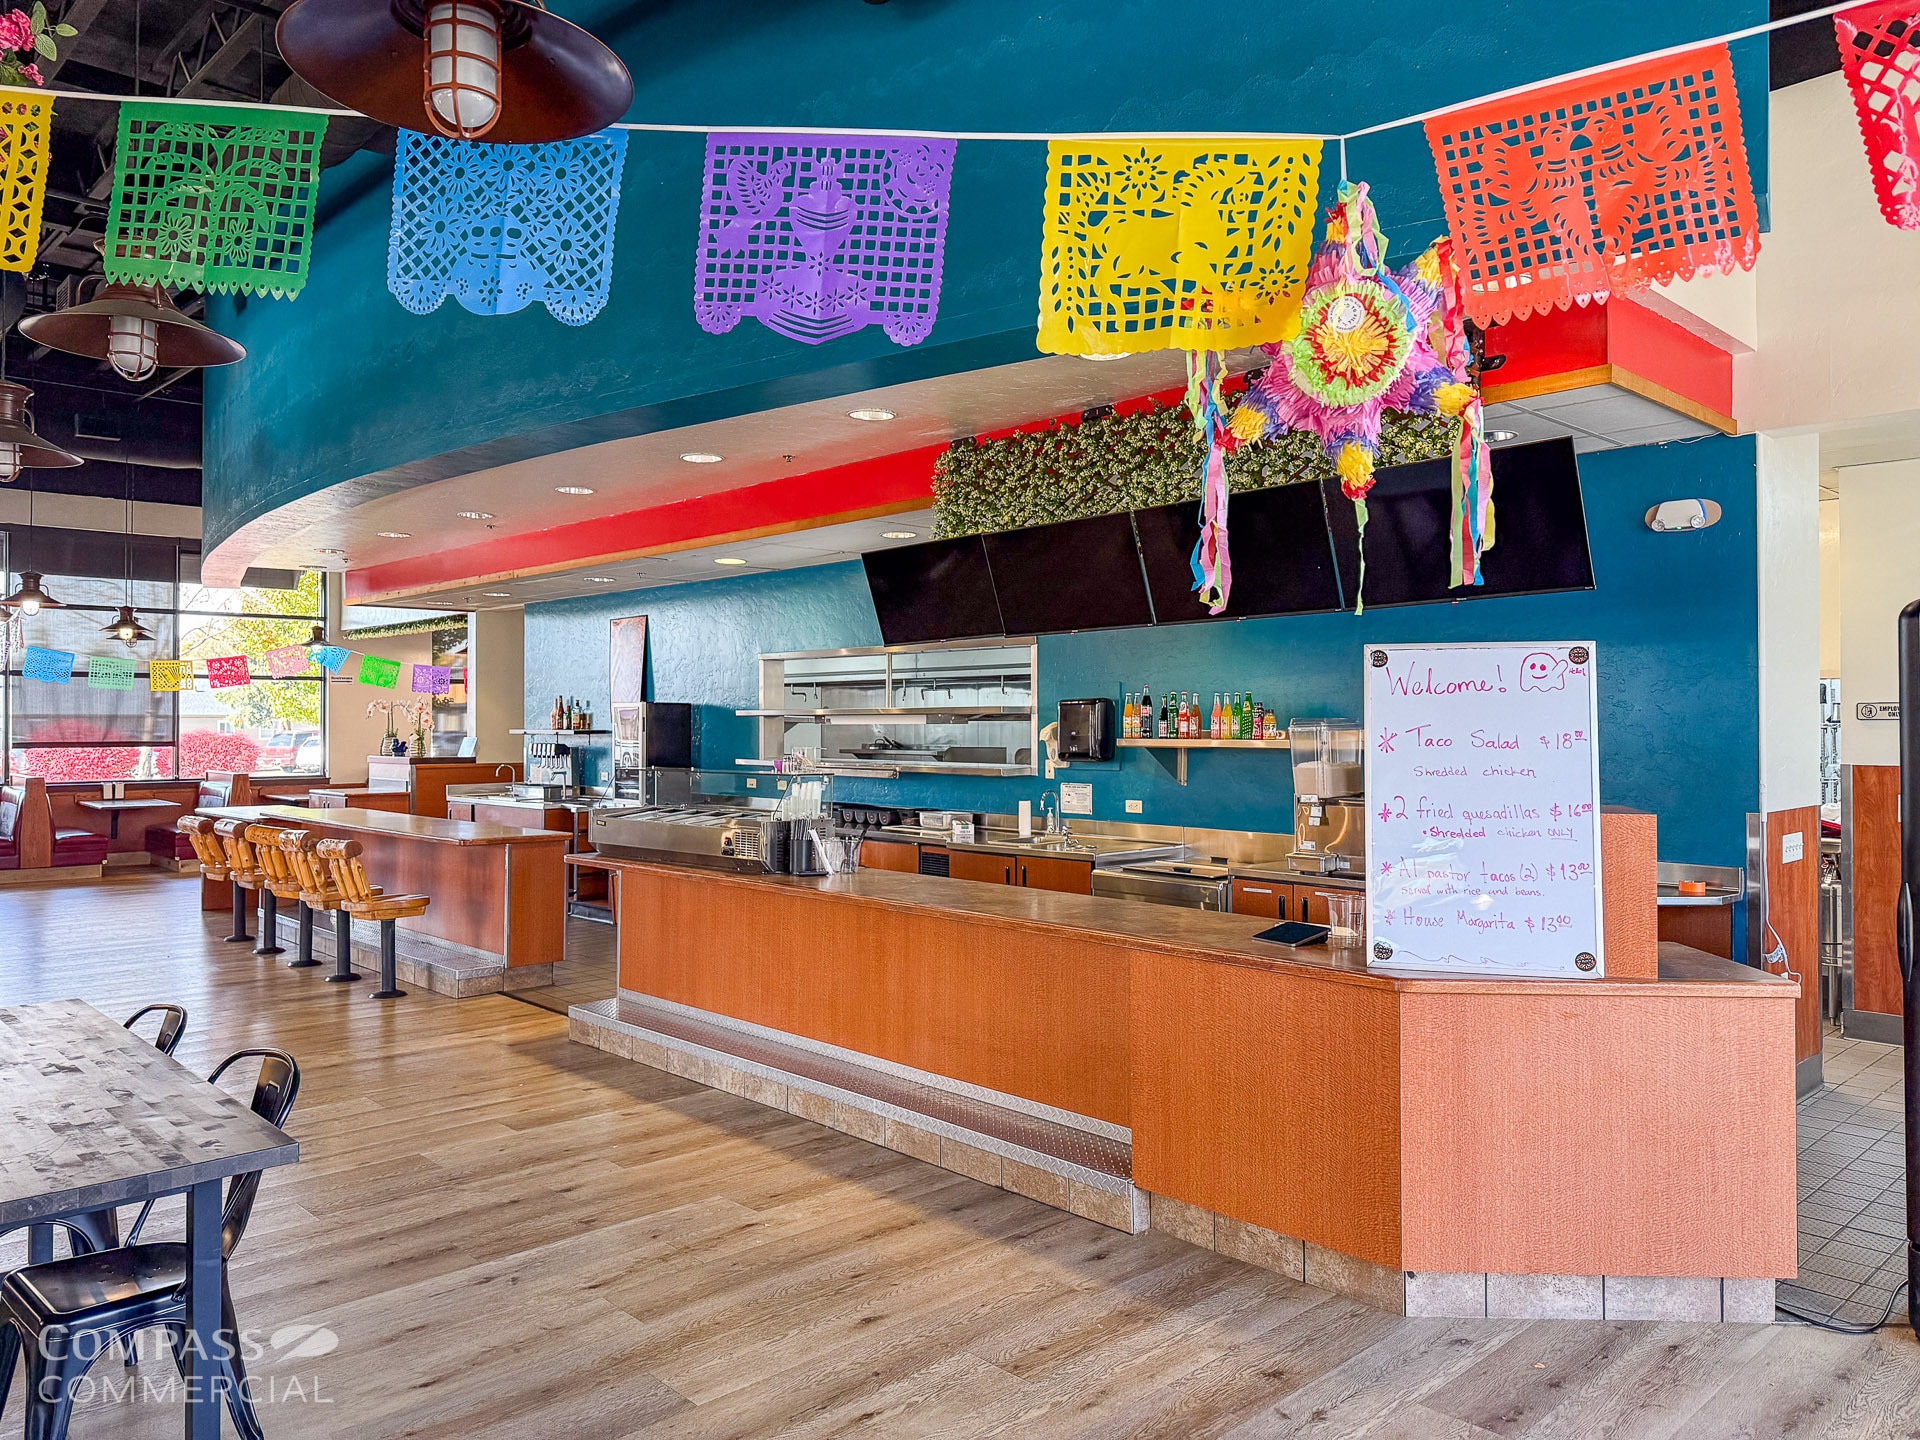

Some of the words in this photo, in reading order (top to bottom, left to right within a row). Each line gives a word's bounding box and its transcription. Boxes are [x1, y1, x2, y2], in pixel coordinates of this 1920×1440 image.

[1386, 661, 1507, 696] Welcome!
[1405, 724, 1453, 748] Taco
[1470, 729, 1520, 750] Salad
[1482, 765, 1537, 779] chicken
[1416, 795, 1454, 819] fried
[1462, 803, 1541, 826] quesadillas
[1496, 826, 1542, 838] chicken
[1547, 827, 1575, 840] ONLY
[1426, 863, 1471, 883] pastor
[1479, 860, 1517, 884] tacos
[1519, 862, 1539, 882] (2)
[1436, 882, 1459, 895] with
[1463, 884, 1481, 896] rice
[1488, 886, 1509, 896] and
[1403, 905, 1444, 928] House
[1456, 910, 1516, 935] Margarita
